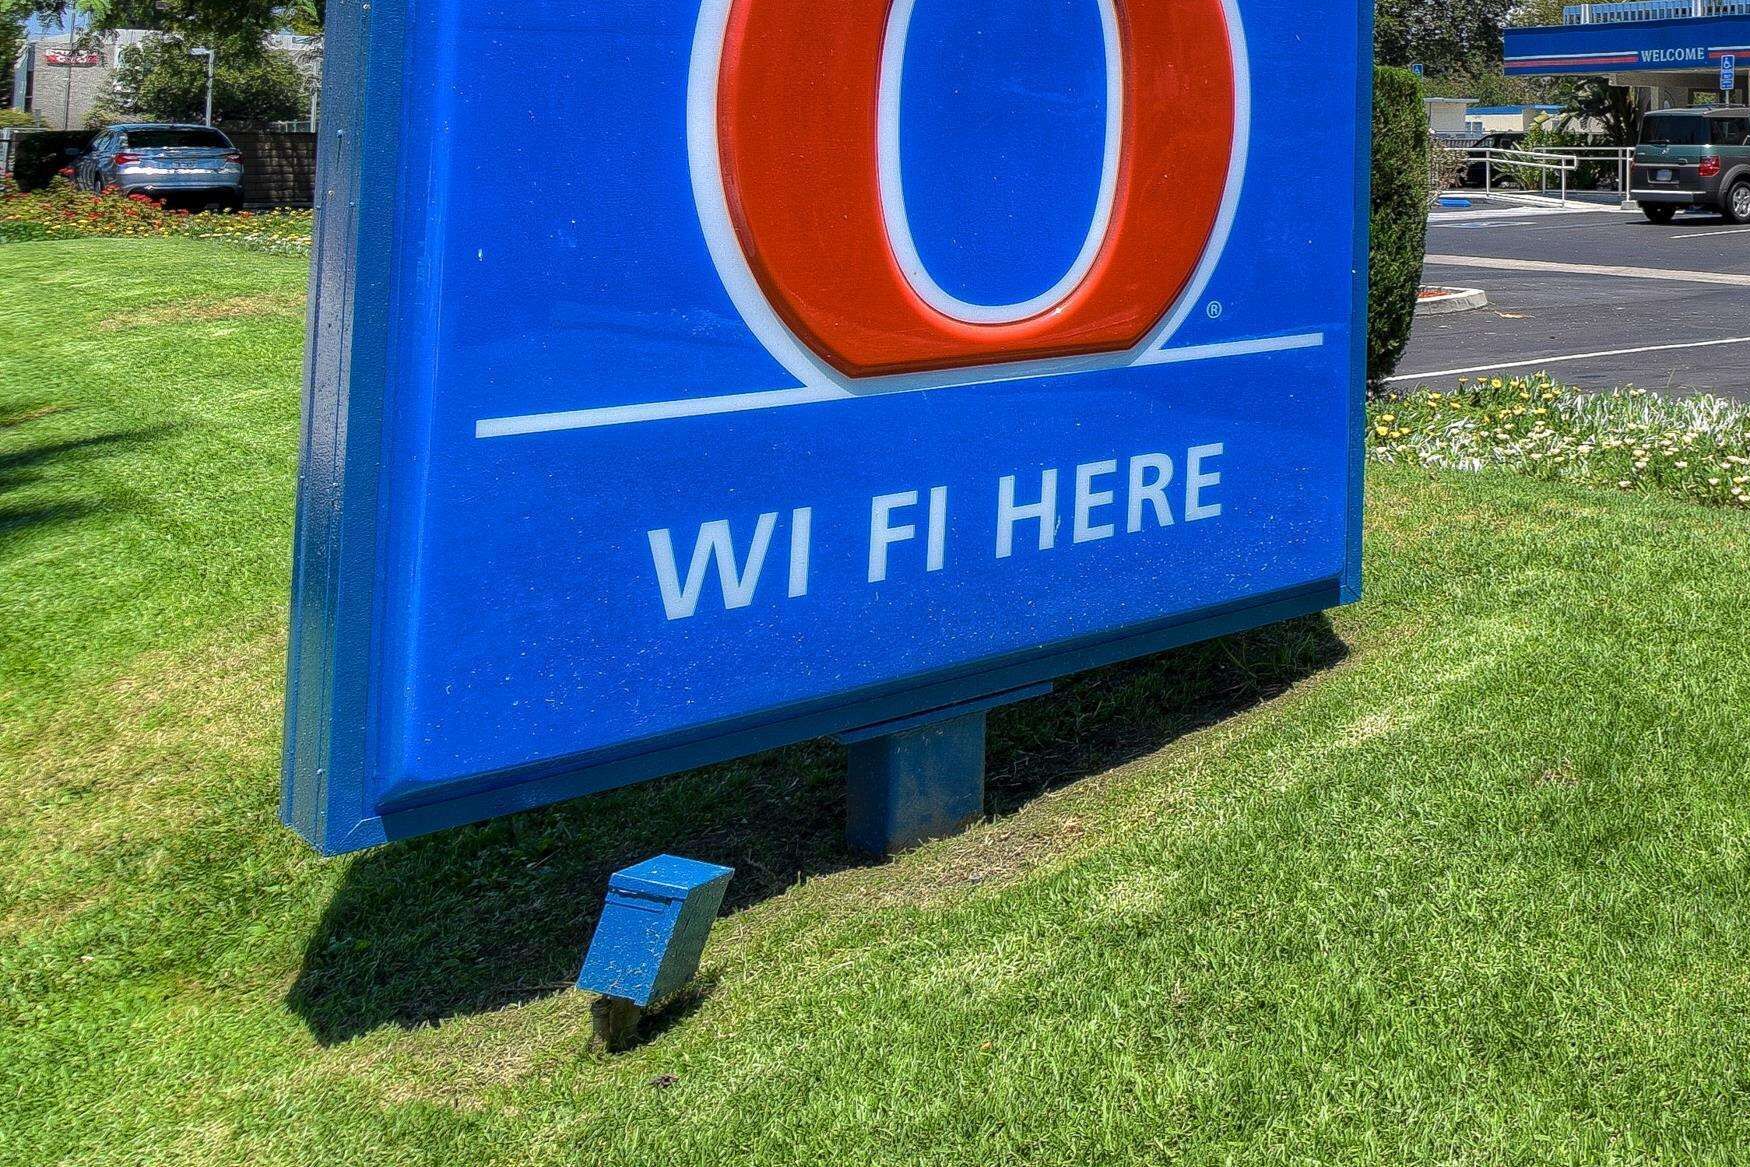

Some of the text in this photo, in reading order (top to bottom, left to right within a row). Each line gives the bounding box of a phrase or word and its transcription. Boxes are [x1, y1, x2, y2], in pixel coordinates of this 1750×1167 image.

[1640, 47, 1705, 62] WELCOME
[647, 442, 1224, 621] WI FI HERE
